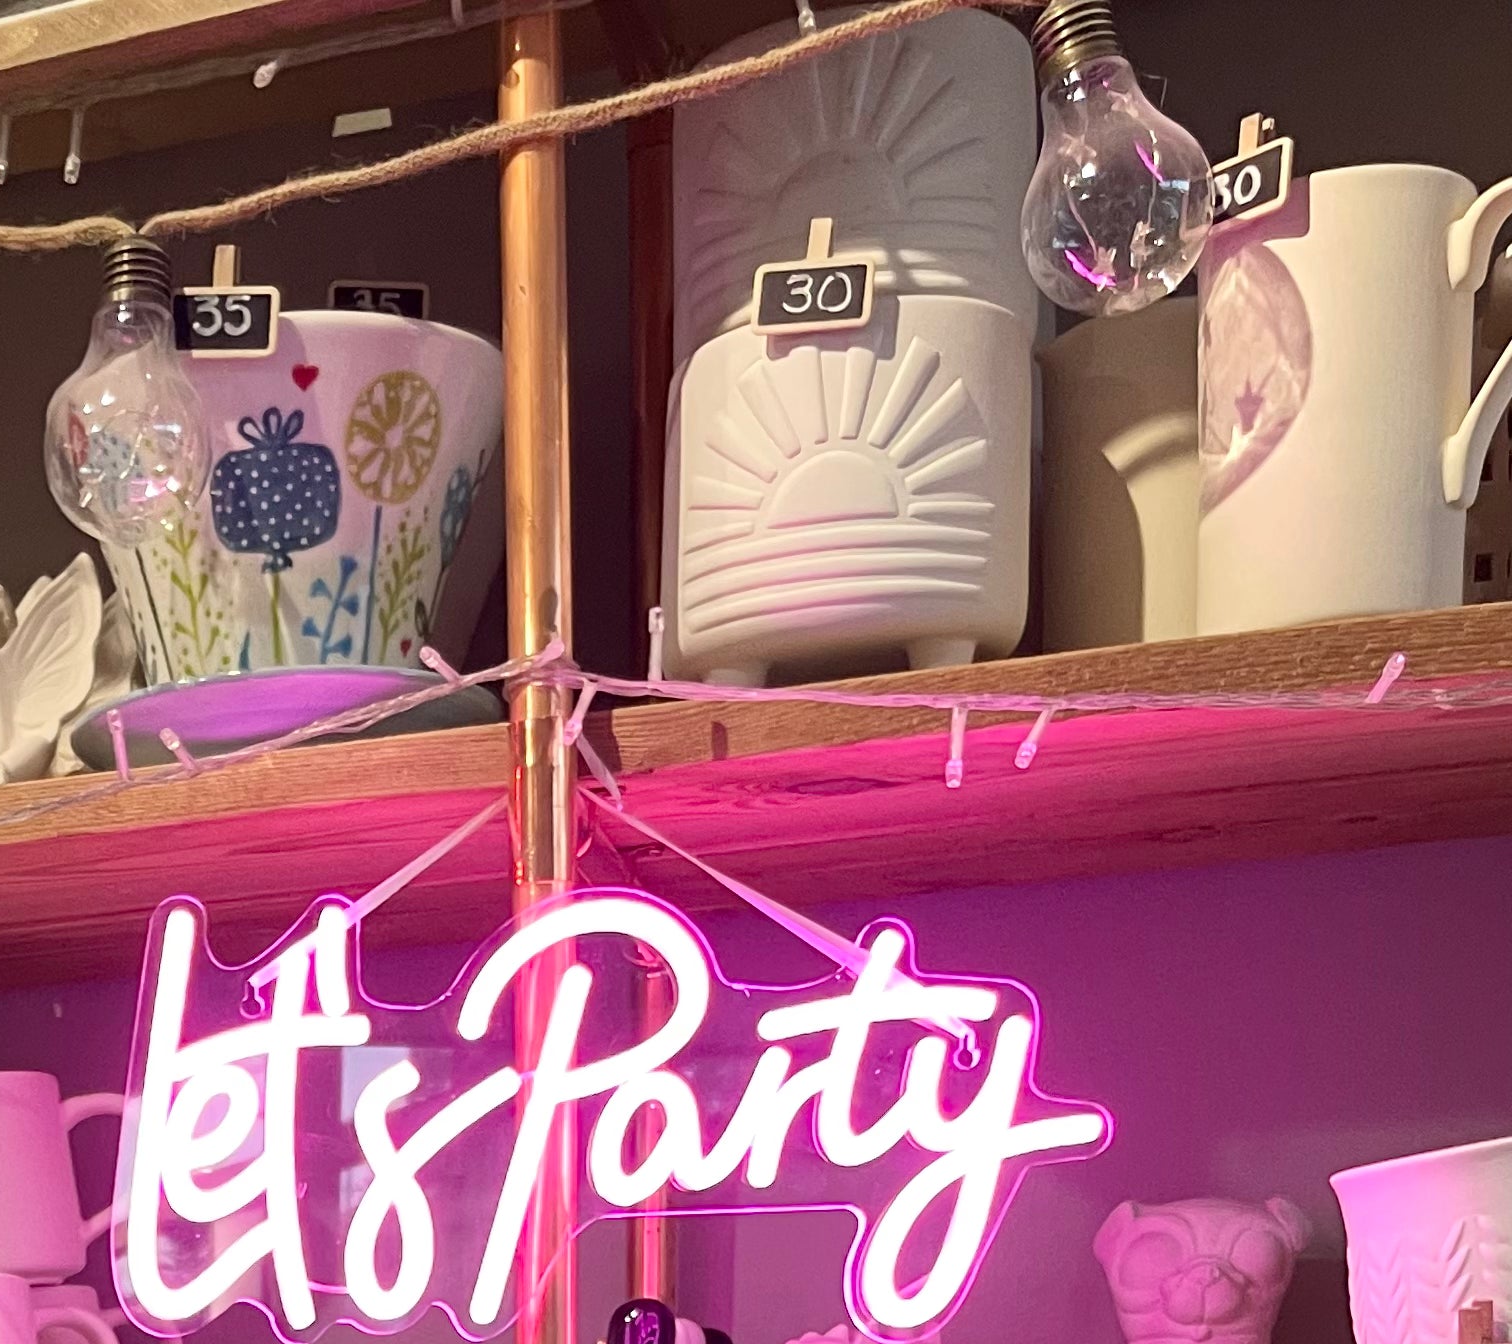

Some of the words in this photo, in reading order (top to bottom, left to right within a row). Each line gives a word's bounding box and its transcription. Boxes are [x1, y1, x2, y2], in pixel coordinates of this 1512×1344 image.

[782, 271, 852, 313] 30
[191, 294, 253, 337] 35
[457, 898, 1104, 1329] Party
